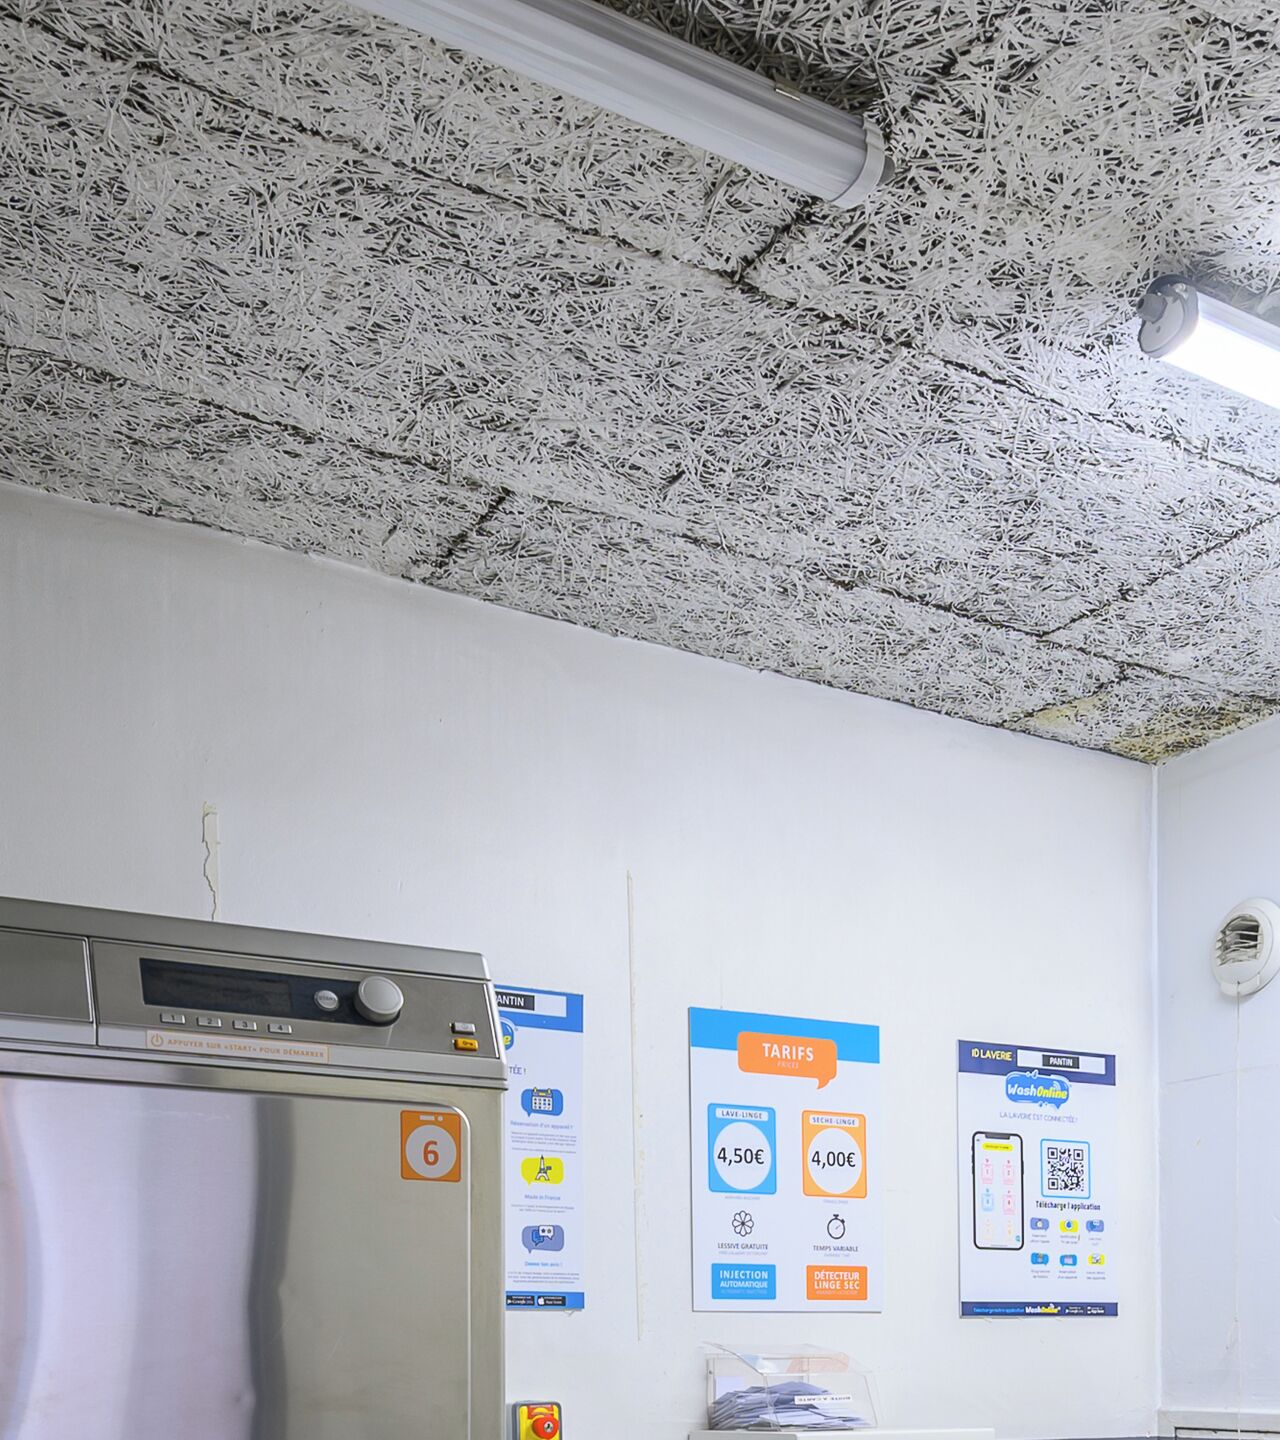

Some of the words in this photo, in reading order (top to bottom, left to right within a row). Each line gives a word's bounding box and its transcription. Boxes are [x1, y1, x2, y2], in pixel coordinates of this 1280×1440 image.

[496, 994, 524, 1007] ANTIN
[168, 1039, 203, 1048] APPUYER
[762, 1043, 814, 1061] TARIFS
[972, 1048, 978, 1057] ID
[980, 1050, 1012, 1061] LAVERIE
[1050, 1057, 1073, 1066] PANTIN
[1008, 1084, 1067, 1099] WashOnline
[722, 1110, 762, 1119] LAVE-LINGE
[424, 1141, 439, 1166] 6
[717, 1147, 764, 1166] 4,50€
[812, 1151, 856, 1169] 4,00€
[721, 1270, 768, 1279] INJECTION
[814, 1270, 859, 1280] DÉTECTEUR
[720, 1280, 768, 1288] AUTOMATIQUE
[814, 1281, 840, 1289] LINGE
[844, 1281, 859, 1289] SEC
